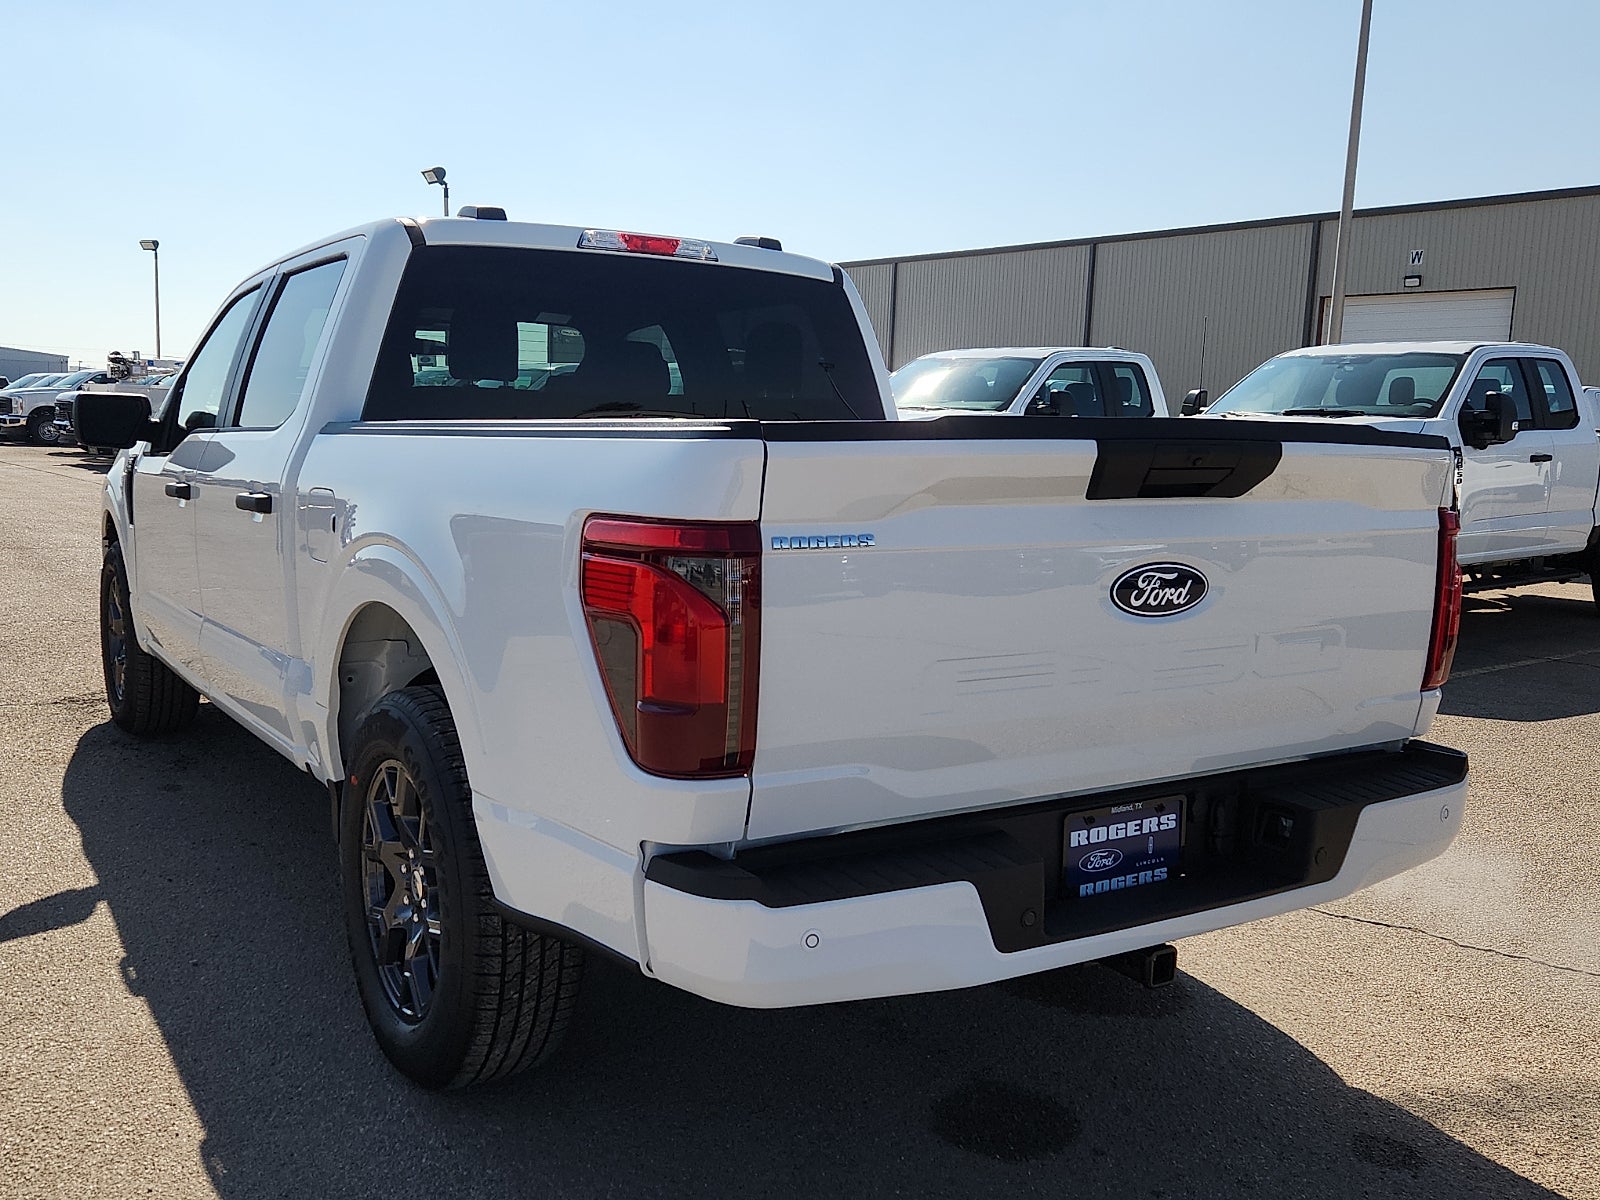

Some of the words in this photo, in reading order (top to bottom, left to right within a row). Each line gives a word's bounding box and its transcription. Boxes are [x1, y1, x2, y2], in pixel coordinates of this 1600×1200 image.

[1411, 250, 1423, 264] W
[771, 533, 876, 550] ROGERS
[1130, 571, 1193, 607] Ford
[1135, 802, 1143, 810] TX
[1070, 813, 1177, 847] ROGERS
[1087, 852, 1114, 869] Ford
[1079, 867, 1168, 897] ROGERS
